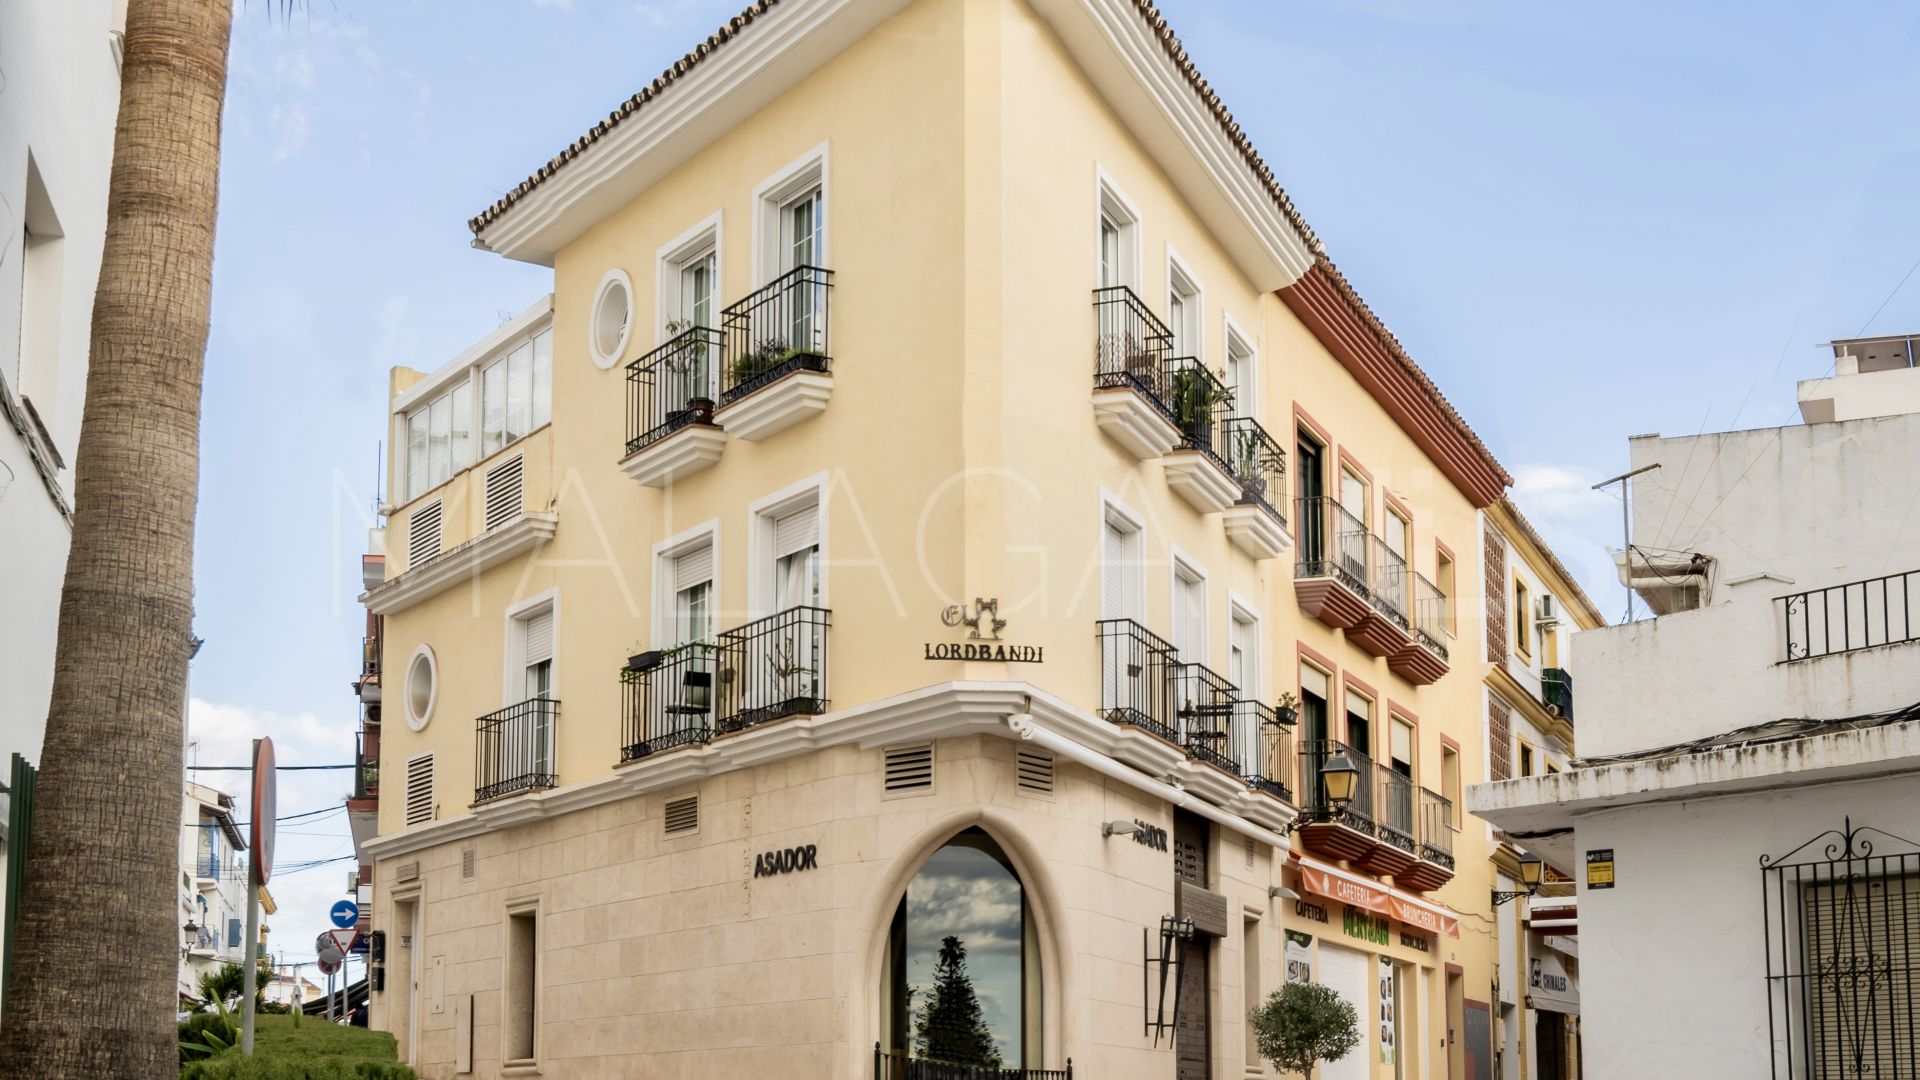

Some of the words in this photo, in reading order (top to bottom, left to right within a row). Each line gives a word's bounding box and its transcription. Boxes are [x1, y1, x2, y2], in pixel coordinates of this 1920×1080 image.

[925, 643, 1043, 663] LORDBANDI
[753, 844, 818, 878] ASADOR
[1337, 879, 1371, 905] CAFETERIA
